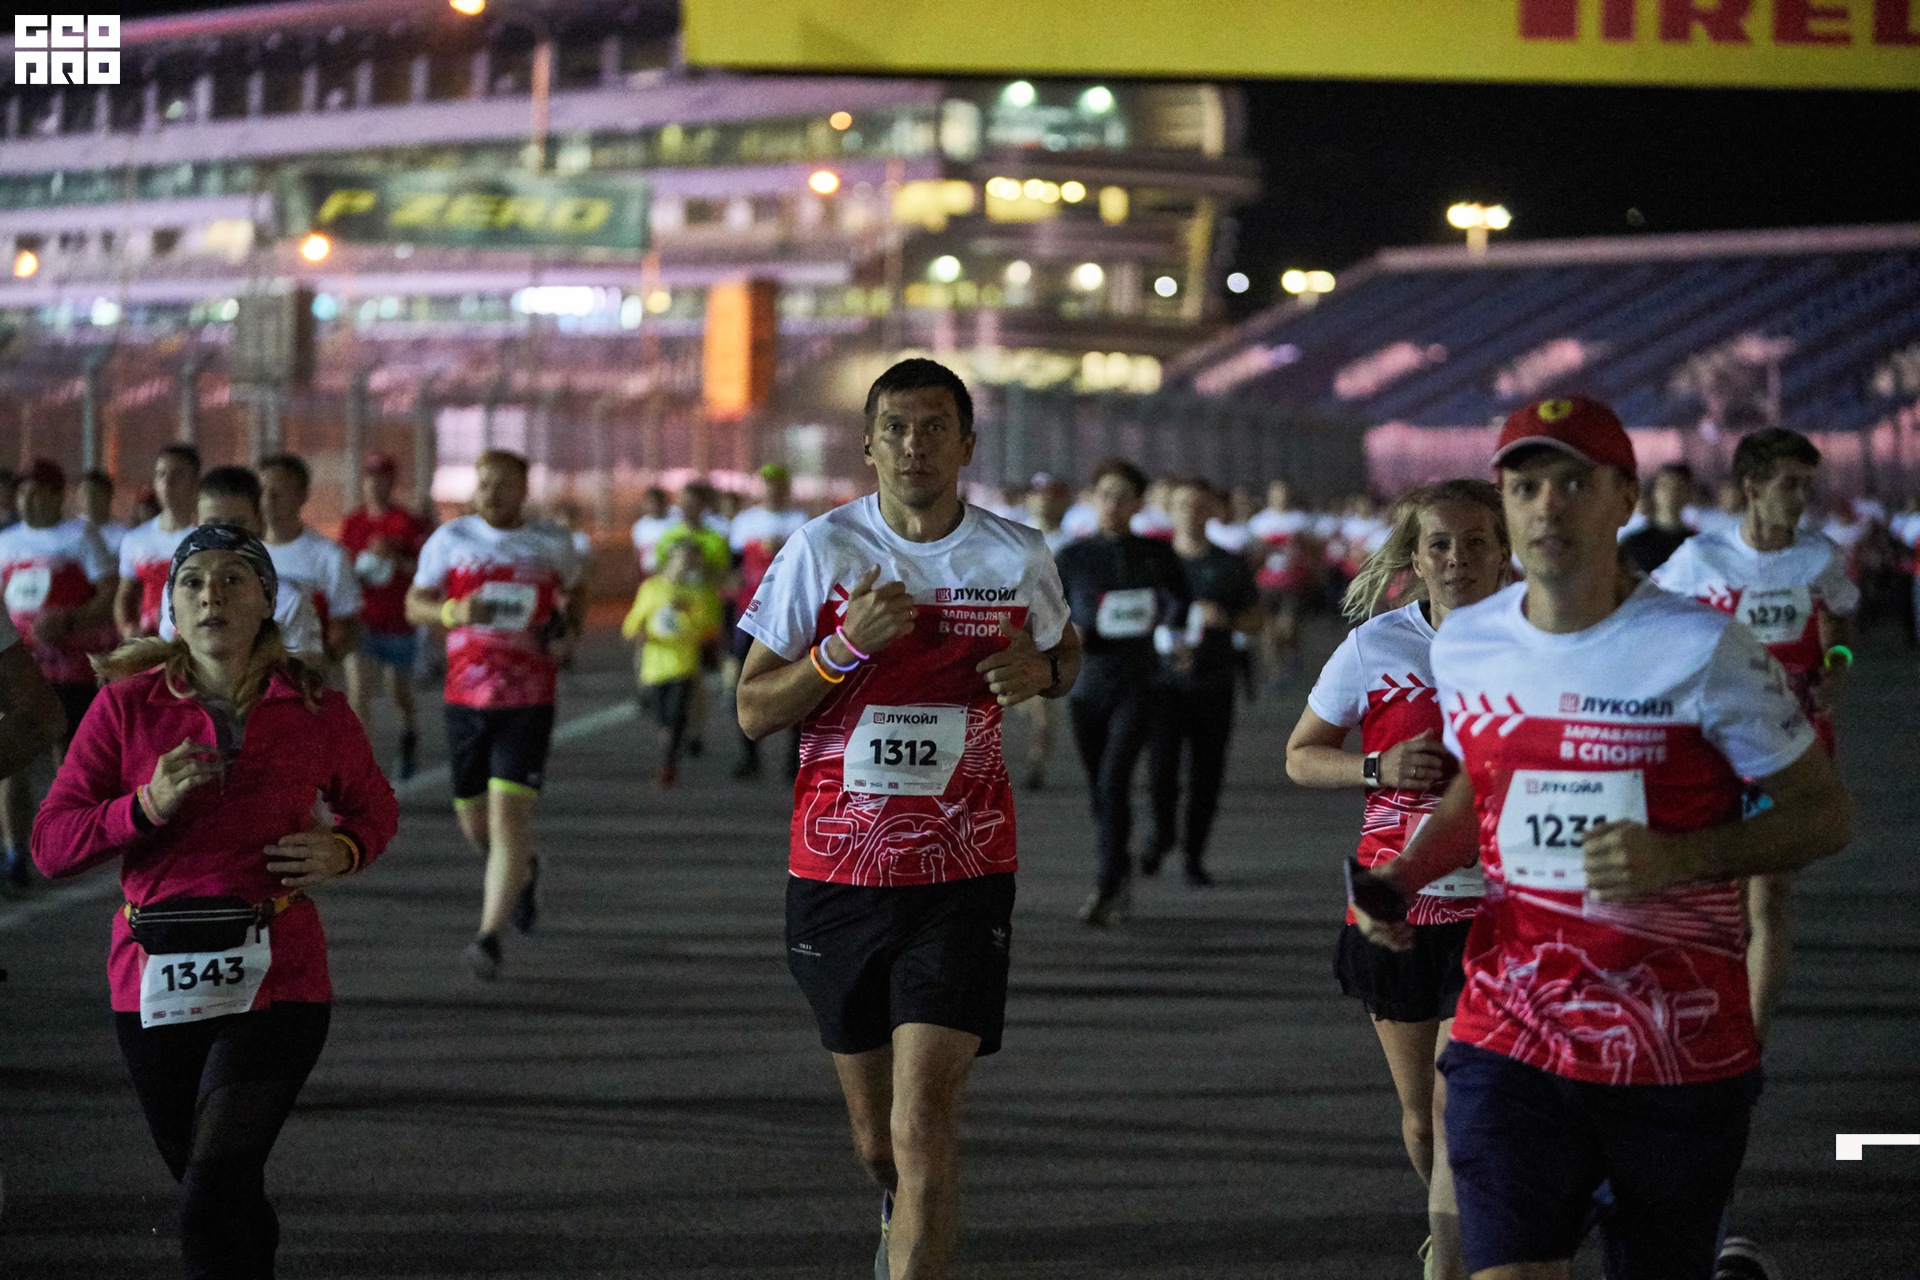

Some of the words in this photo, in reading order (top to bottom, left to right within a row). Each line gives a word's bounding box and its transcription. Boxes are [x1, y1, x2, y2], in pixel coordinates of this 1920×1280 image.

[390, 192, 614, 232] ZERO
[953, 586, 1017, 602] ЛУКОЙЛ
[942, 609, 1011, 621] ЗАПРАВЛЯ
[939, 621, 951, 634] В
[953, 622, 1006, 637] СПОРТ
[1581, 695, 1674, 717] ЛУКОЙЛ
[886, 713, 938, 725] ЛУКОЙЛ
[869, 738, 938, 767] 1312
[1525, 813, 1607, 848] 123
[161, 956, 245, 992] 1343
